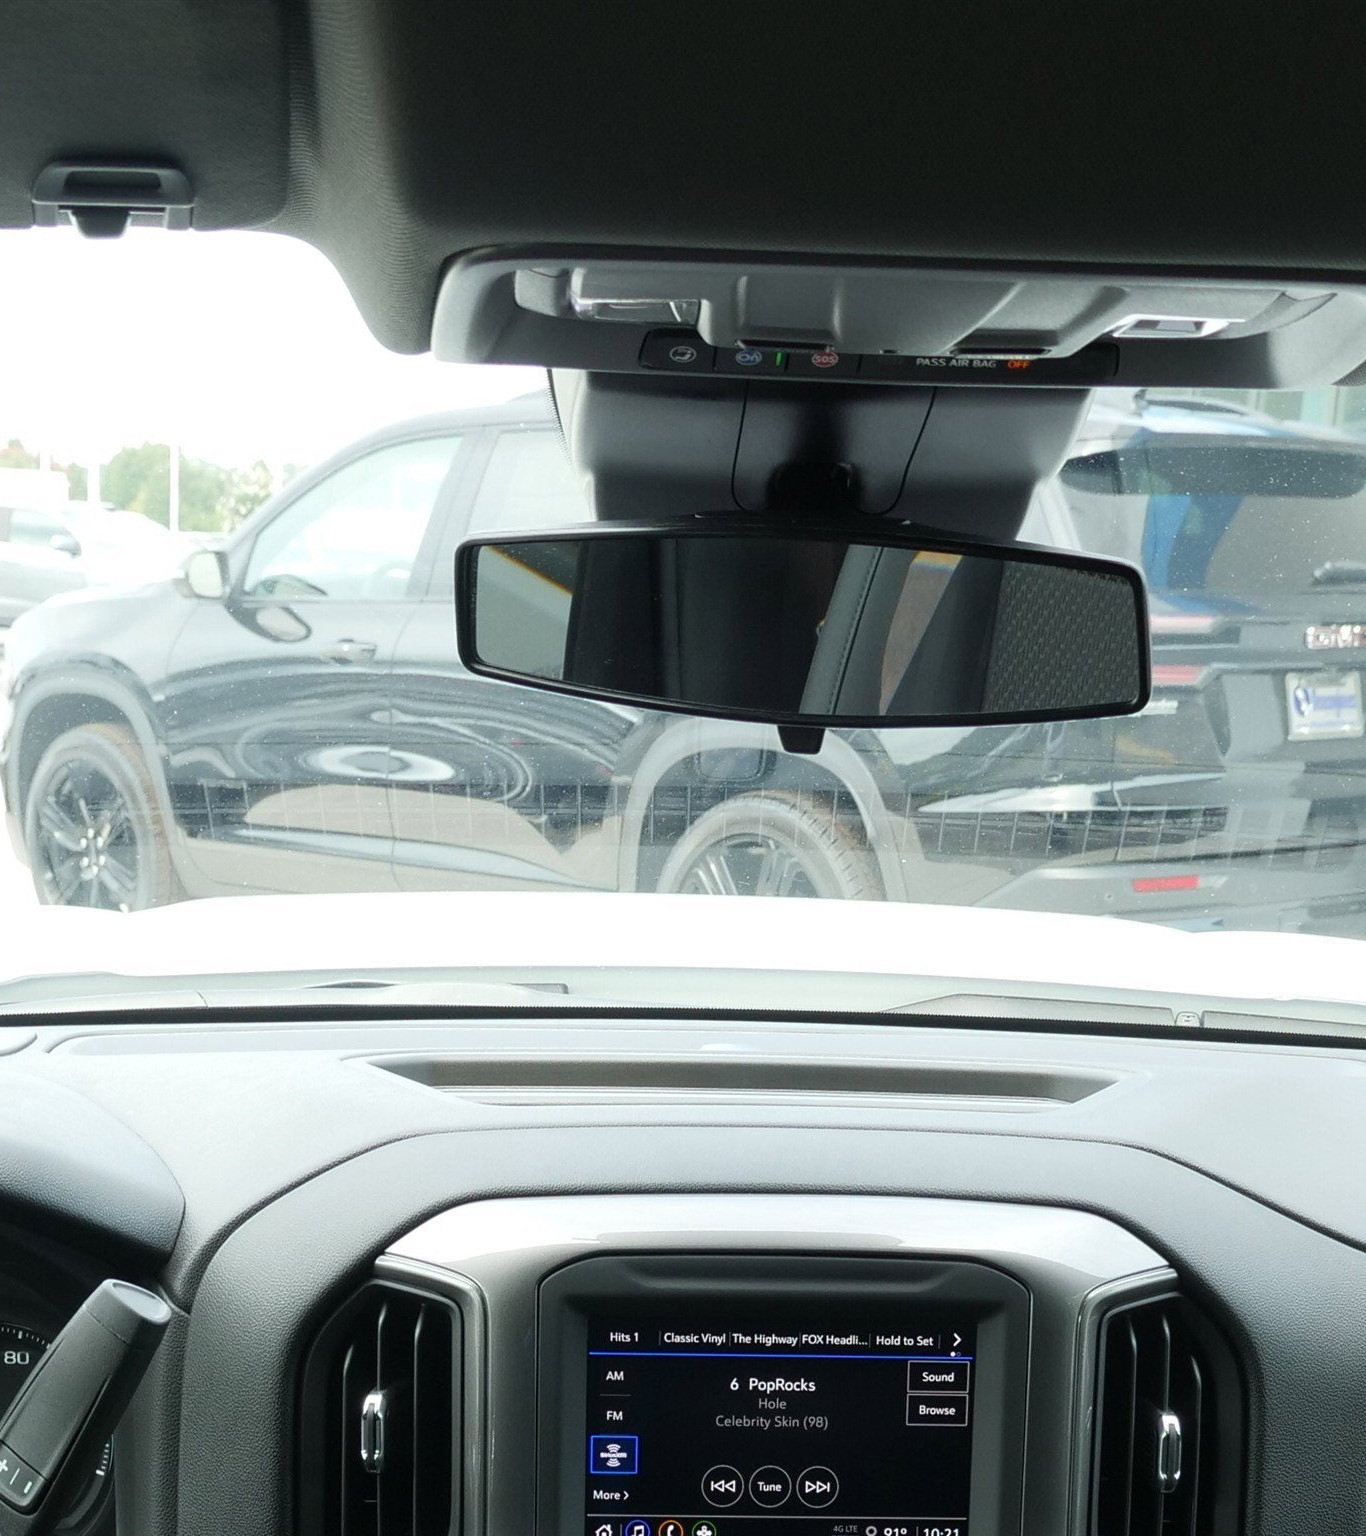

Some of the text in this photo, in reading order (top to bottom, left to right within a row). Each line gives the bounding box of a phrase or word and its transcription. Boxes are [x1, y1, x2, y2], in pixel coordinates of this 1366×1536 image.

[813, 354, 837, 365] SOS
[916, 357, 1030, 369] PASS AIR BAG OFF
[610, 1331, 639, 1343] Hits 1
[664, 1332, 726, 1346] Classic Vinyl
[732, 1333, 798, 1346] The Highway
[802, 1334, 824, 1345] FOX
[876, 1336, 934, 1347] Hold to Set
[4, 1351, 29, 1365] 80
[606, 1370, 625, 1381] AM
[922, 1372, 955, 1382] Sound
[730, 1378, 816, 1394] 6 PopRocks
[758, 1398, 787, 1410] Hole
[606, 1411, 624, 1421] FM
[919, 1405, 956, 1416] Browse
[715, 1415, 829, 1431] Celebrity Skin (98)
[757, 1482, 782, 1492] Tune
[593, 1490, 621, 1500] More
[833, 1525, 858, 1533] 4G LTE
